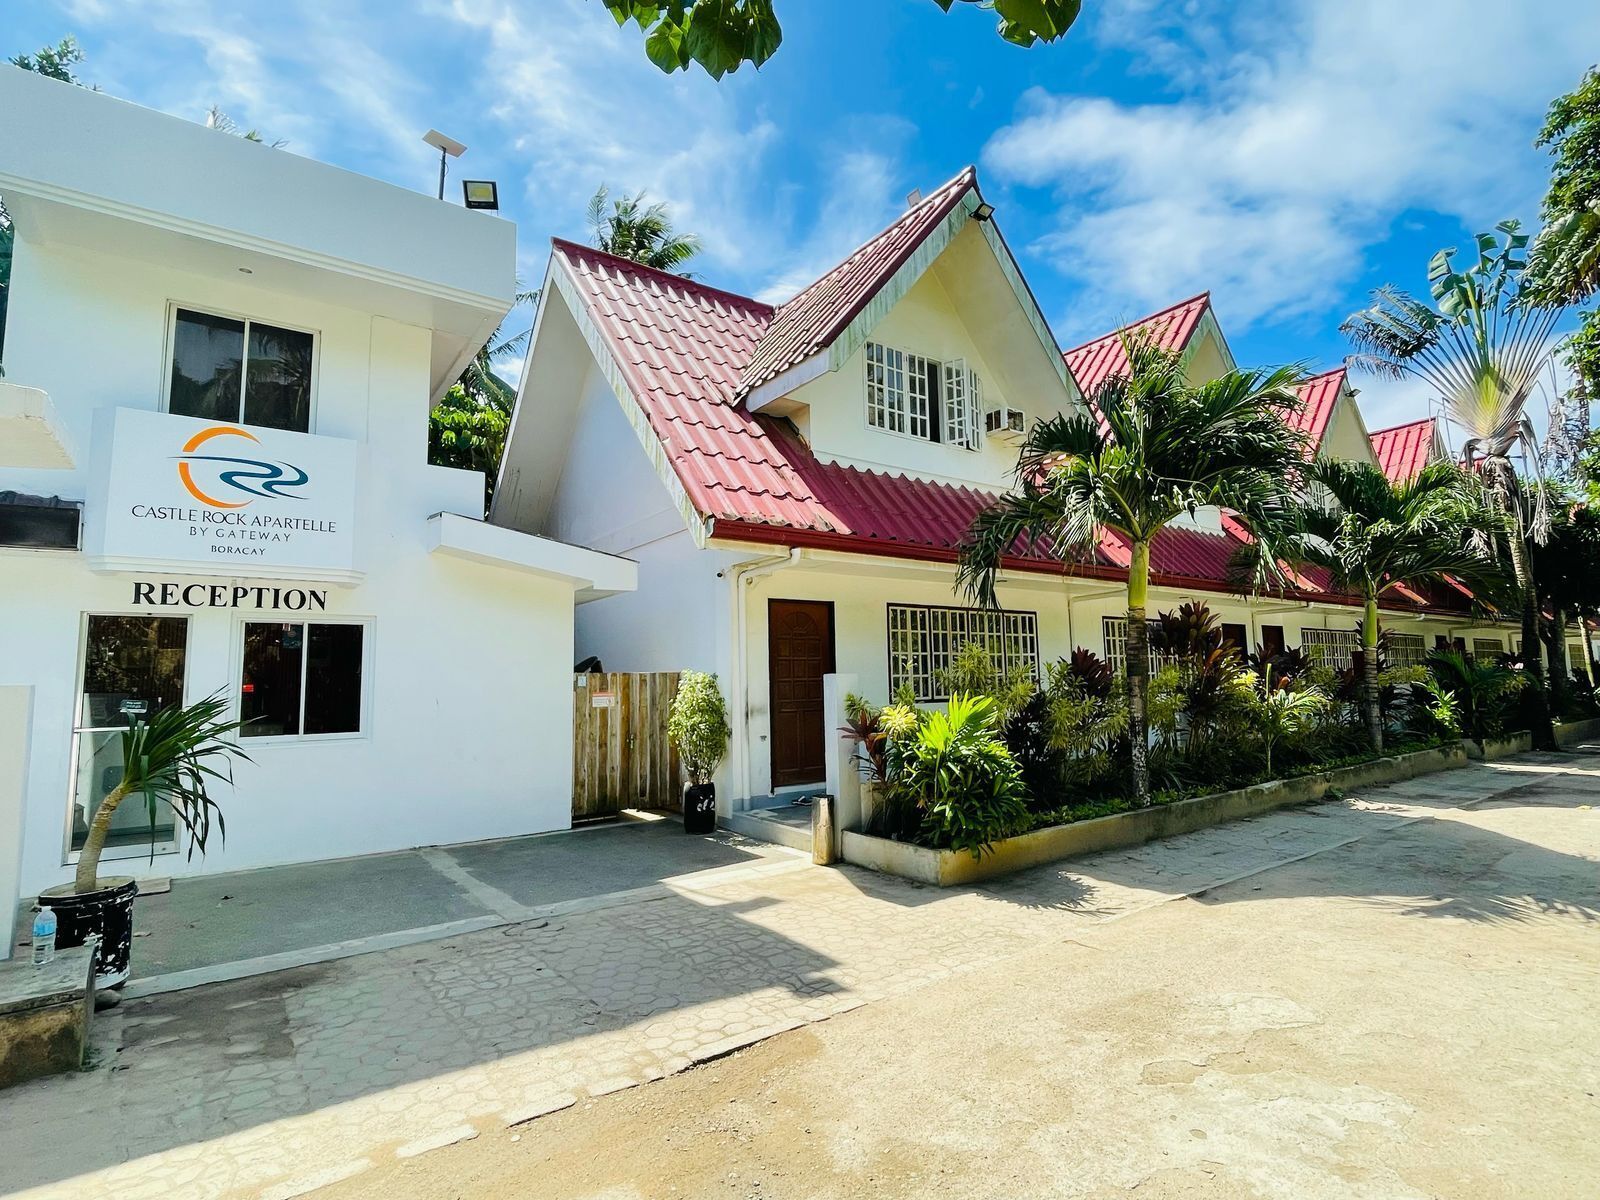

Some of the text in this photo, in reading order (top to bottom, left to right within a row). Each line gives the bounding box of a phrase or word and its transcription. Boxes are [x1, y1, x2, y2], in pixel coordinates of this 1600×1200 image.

[131, 504, 337, 533] CASTLE ROCK APARTELLE
[189, 526, 292, 542] BY GATEWAY
[211, 545, 266, 556] BORACAY
[131, 582, 328, 611] RECEPTION
